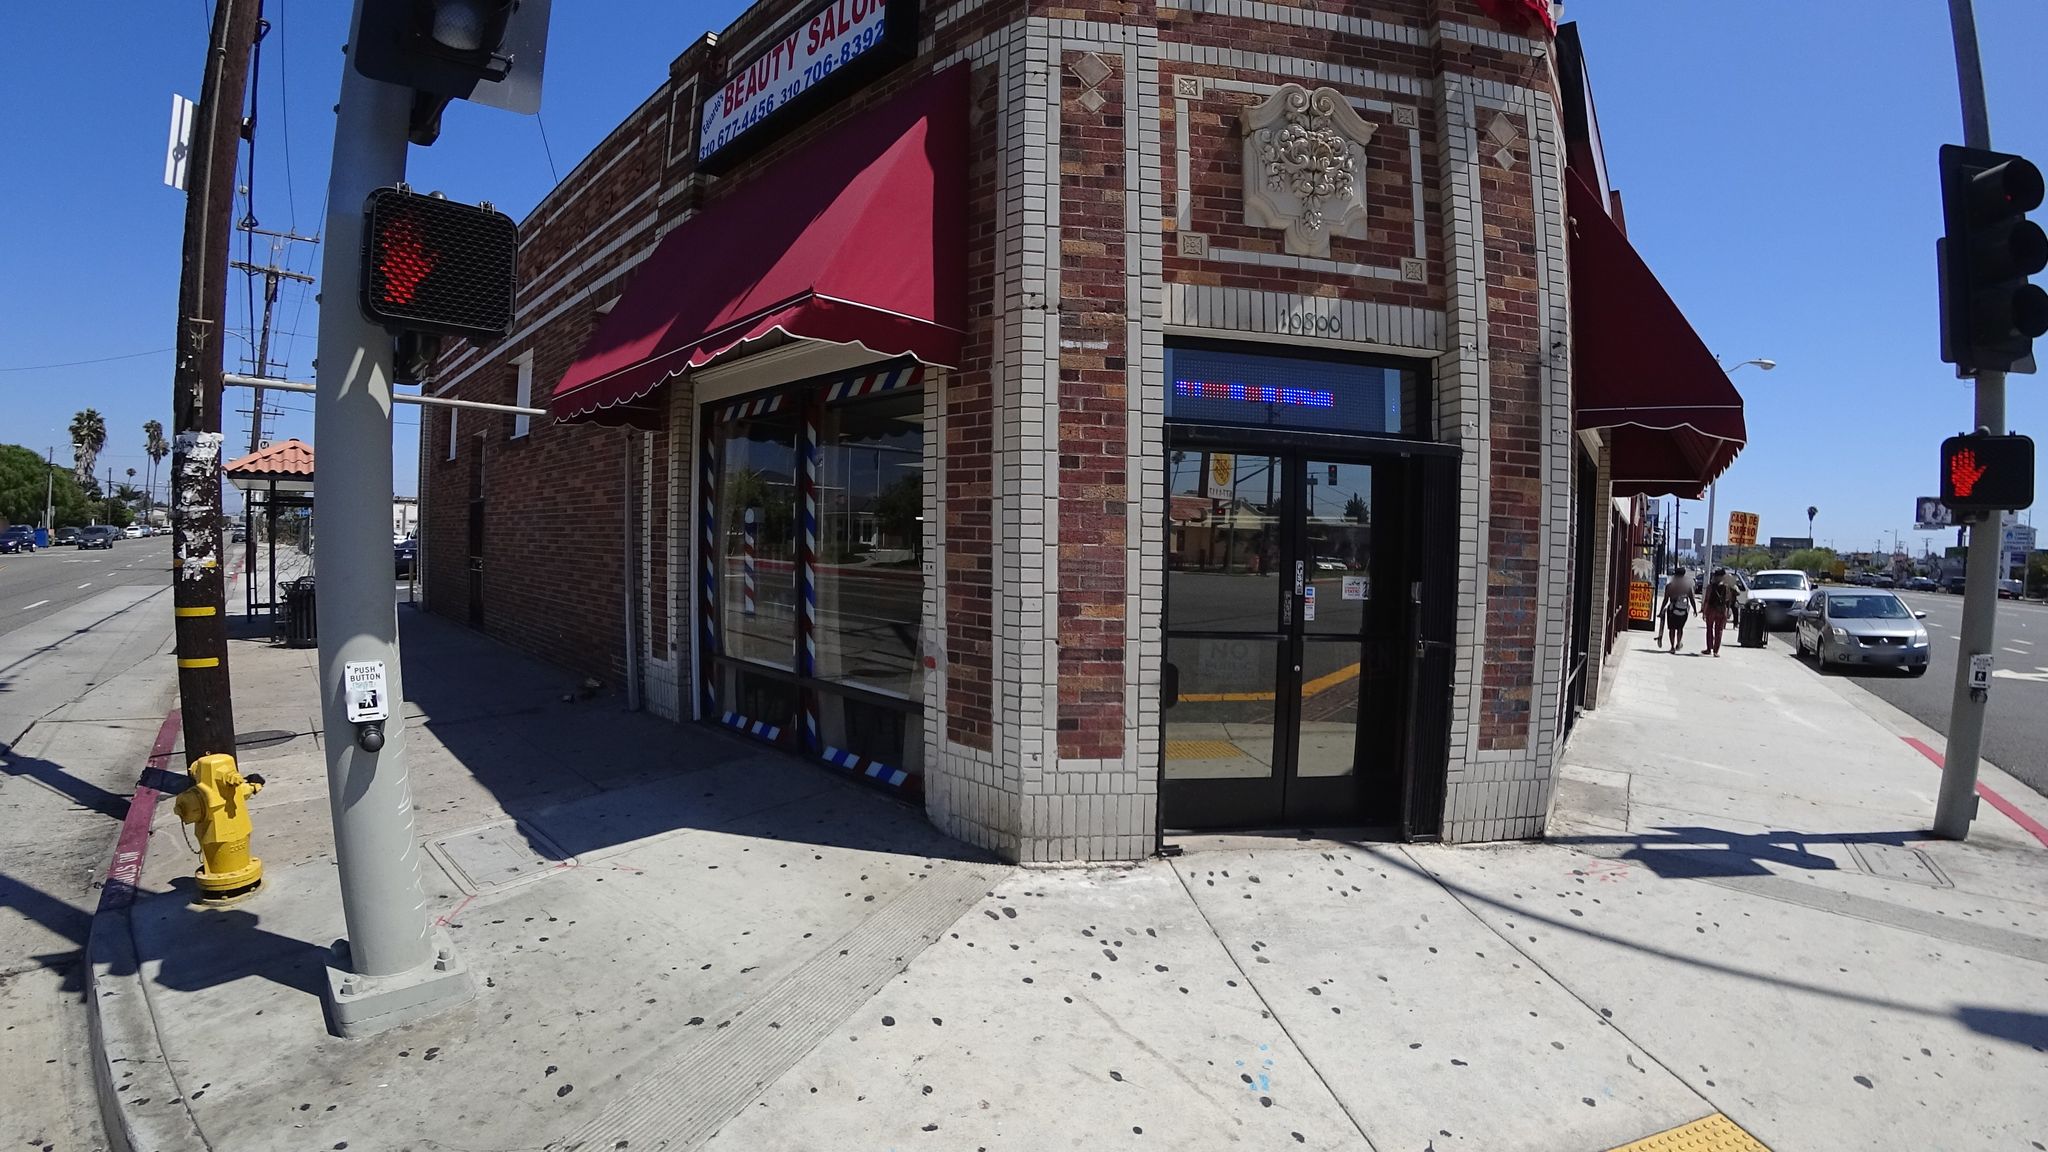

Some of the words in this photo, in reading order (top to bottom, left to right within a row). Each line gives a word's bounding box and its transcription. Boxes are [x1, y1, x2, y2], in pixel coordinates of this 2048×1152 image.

[780, 79, 800, 105] 310
[804, 19, 885, 89] 706-8392
[723, 31, 801, 118] BEAUTY
[703, 94, 724, 135] Eduardo's
[699, 139, 715, 161] 310
[717, 93, 775, 148] 677-4456
[1280, 308, 1341, 333] 10800
[1731, 512, 1747, 525] CASA
[1749, 515, 1758, 526] DE
[1630, 609, 1648, 617] ORO
[1211, 641, 1248, 659] NO
[350, 673, 381, 682] BUTTON
[354, 666, 376, 674] PUSH
